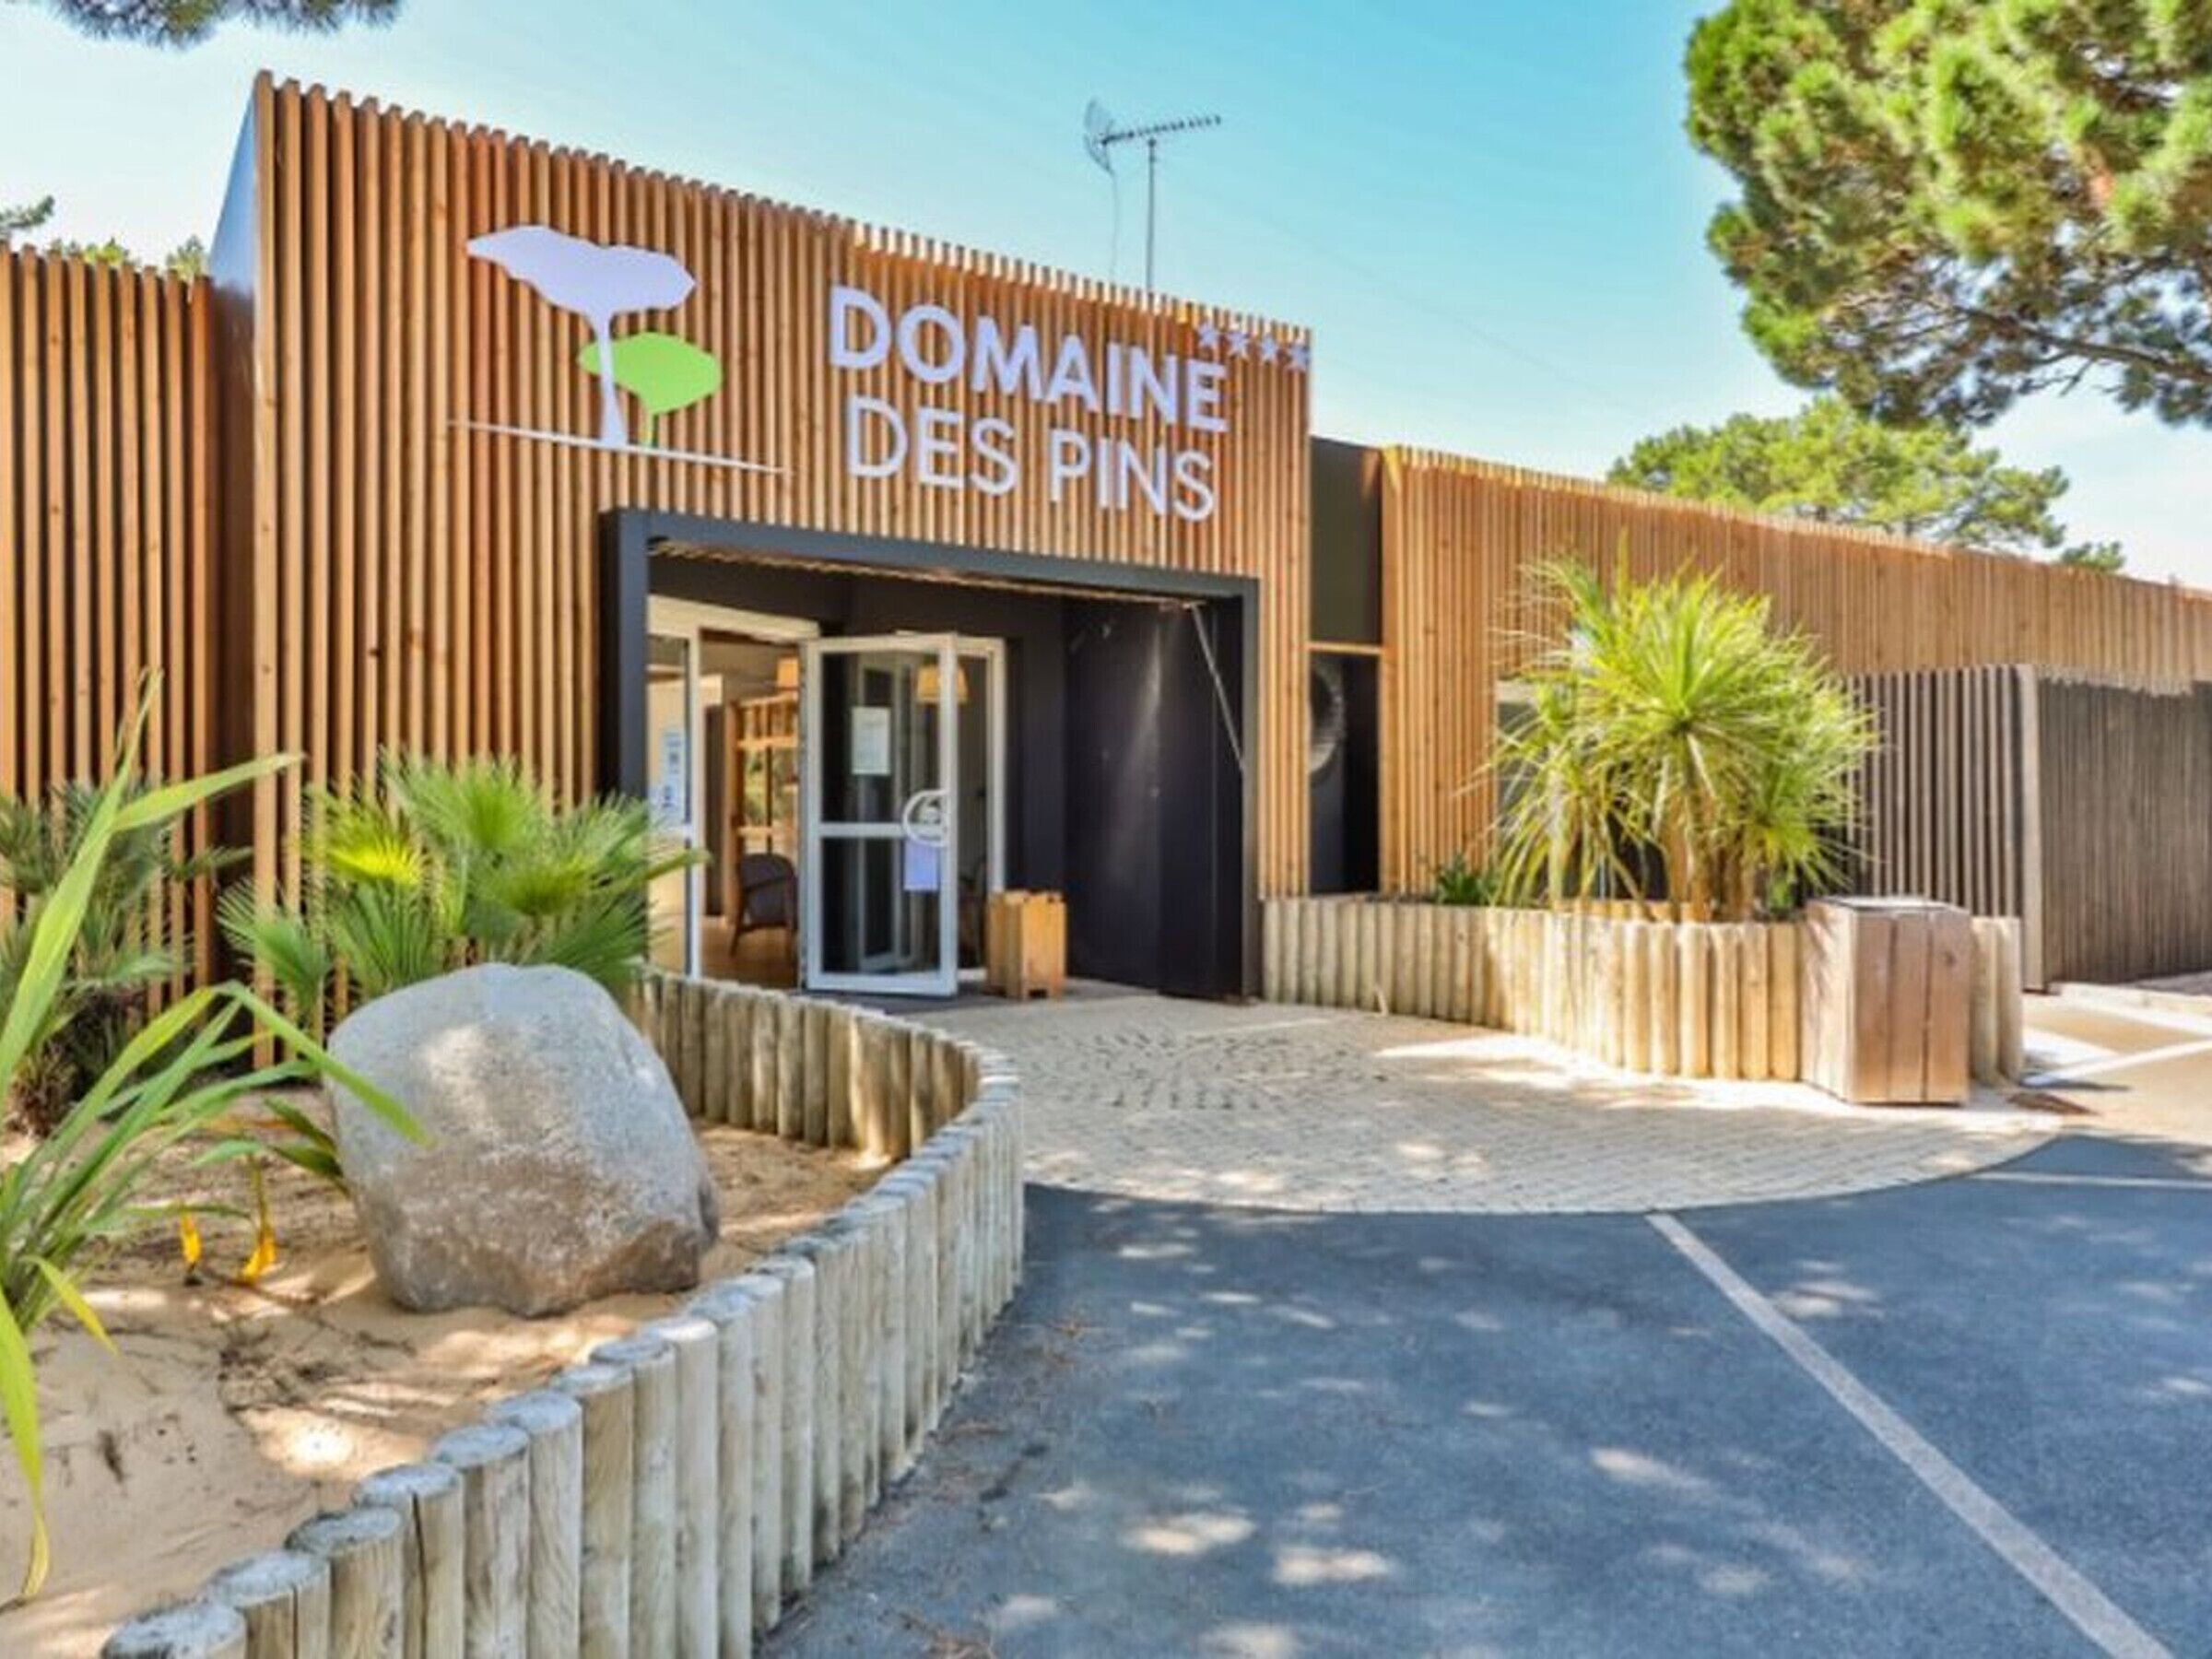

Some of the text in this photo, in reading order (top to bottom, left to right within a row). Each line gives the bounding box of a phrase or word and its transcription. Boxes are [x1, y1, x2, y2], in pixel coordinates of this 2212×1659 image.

[829, 285, 1229, 433] DOMAINE
[848, 395, 1215, 523] DES PINS
